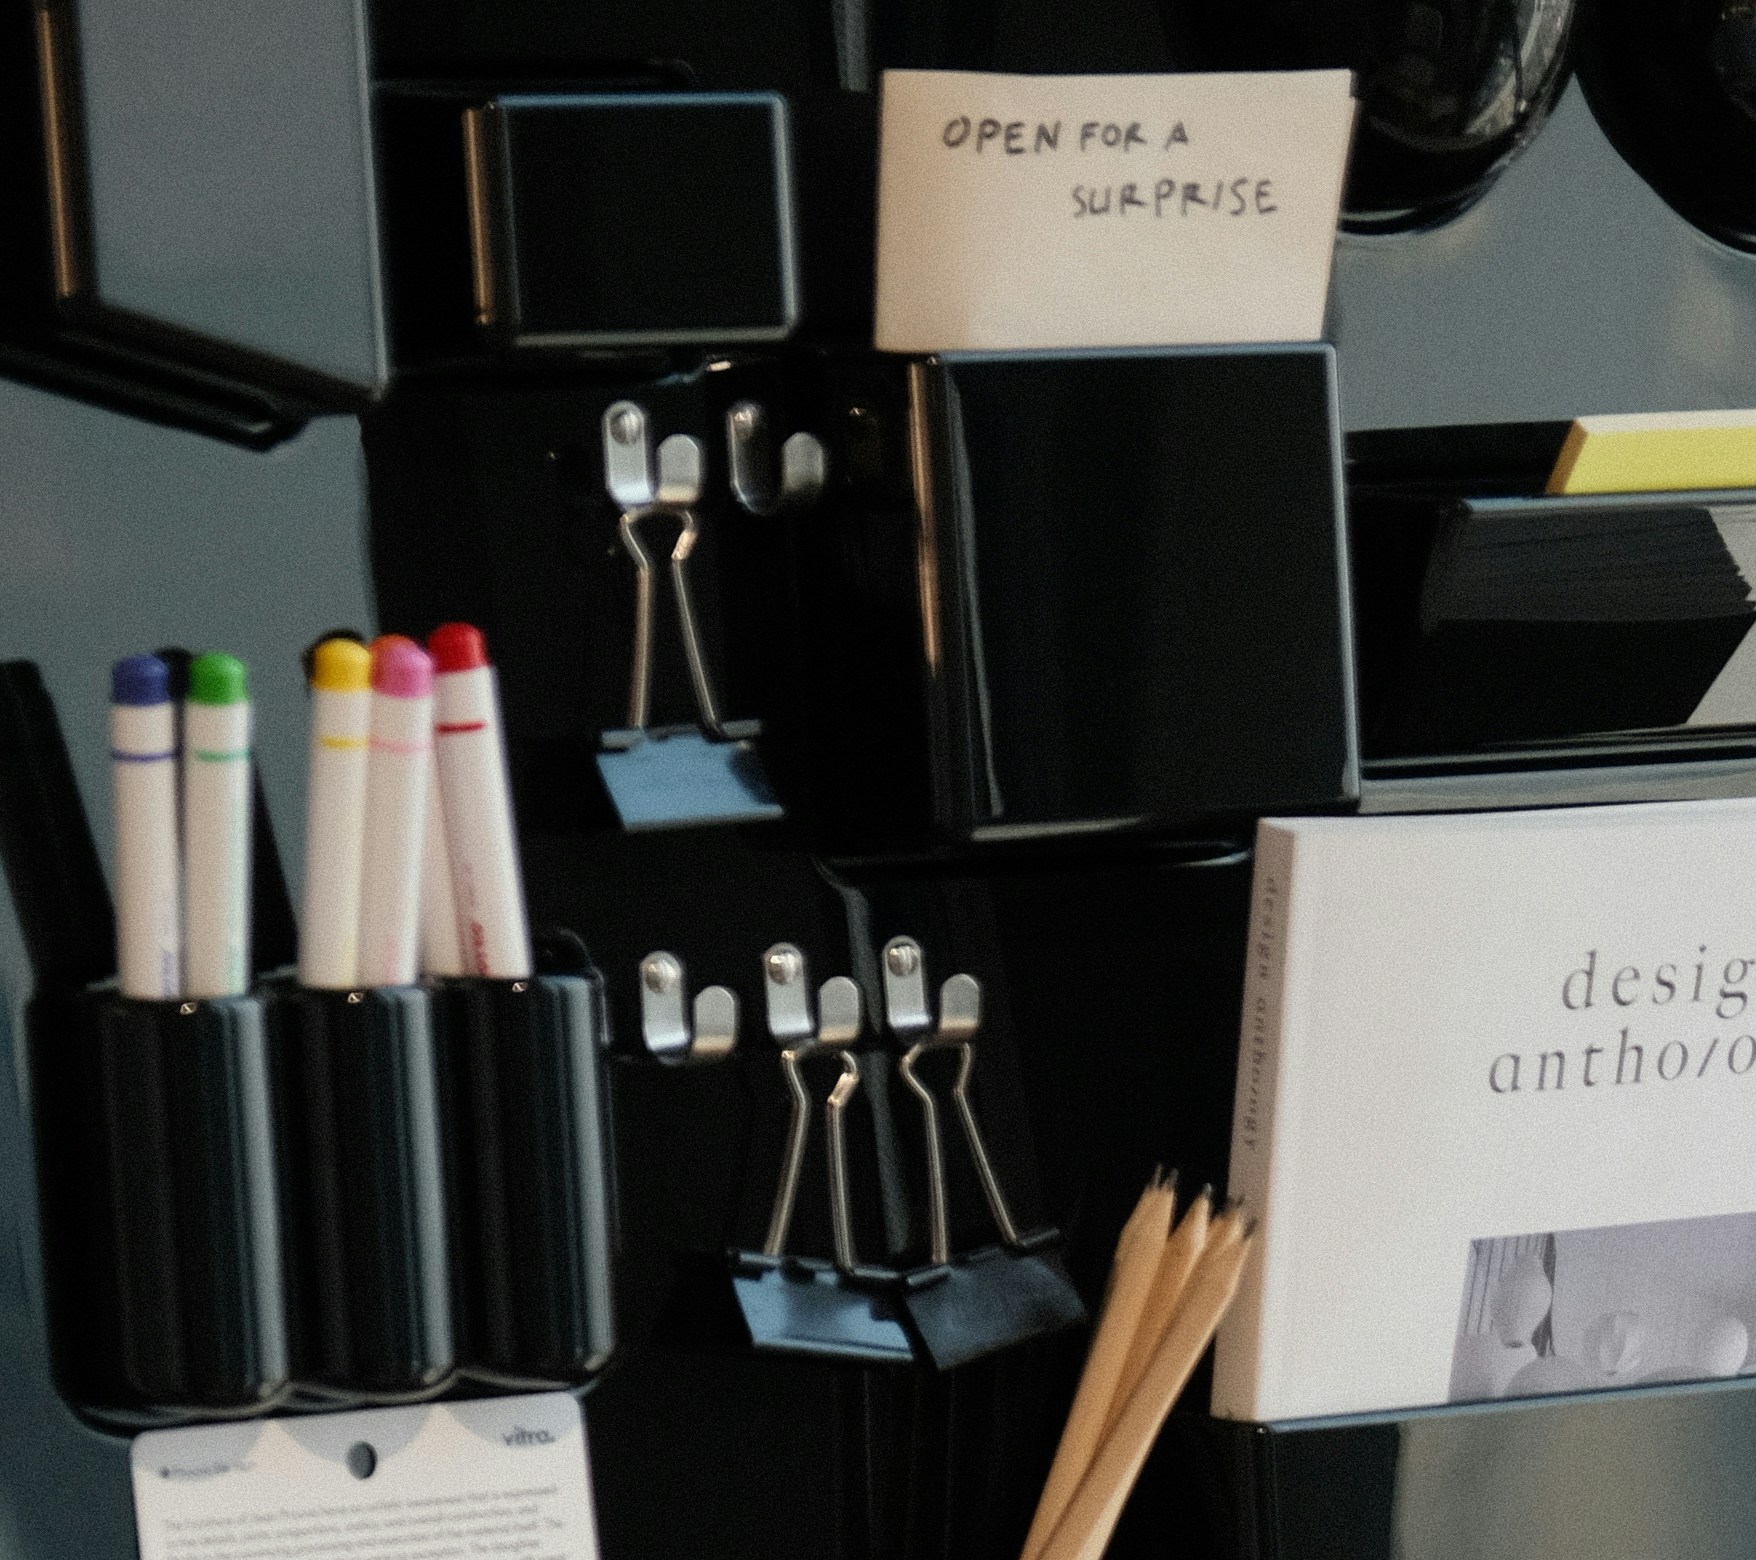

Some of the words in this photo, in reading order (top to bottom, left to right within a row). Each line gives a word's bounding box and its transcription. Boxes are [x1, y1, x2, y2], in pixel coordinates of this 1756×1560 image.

[942, 116, 1062, 155] OPEN
[1080, 121, 1147, 153] FOR
[1163, 120, 1189, 151] A
[1072, 177, 1278, 219] SURPRISE
